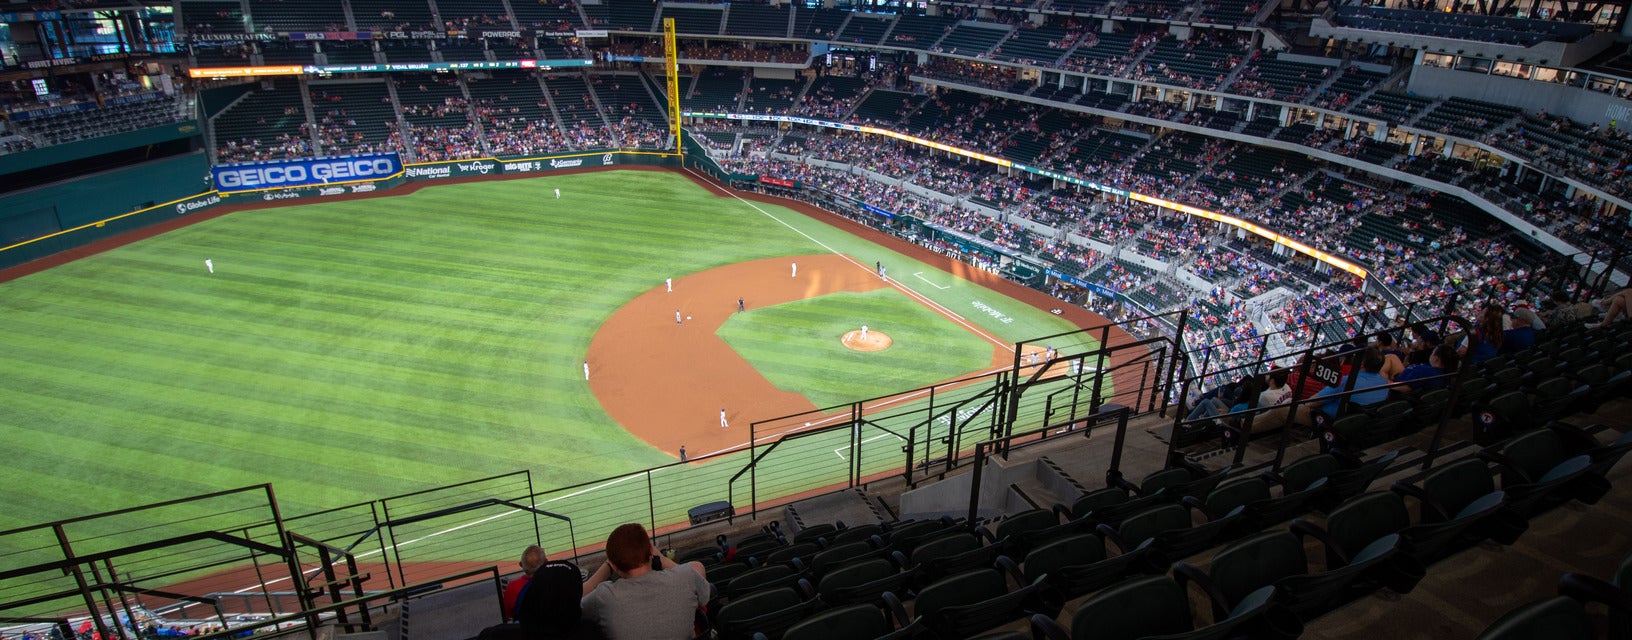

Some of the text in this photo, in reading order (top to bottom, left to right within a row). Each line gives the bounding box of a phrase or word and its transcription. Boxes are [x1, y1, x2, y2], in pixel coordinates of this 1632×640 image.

[218, 159, 393, 187] GEICO GEICO
[416, 165, 451, 176] National
[470, 160, 495, 174] Kroger
[504, 162, 517, 171] BIG
[186, 195, 221, 210] Globe Life
[1315, 365, 1340, 384] 305
